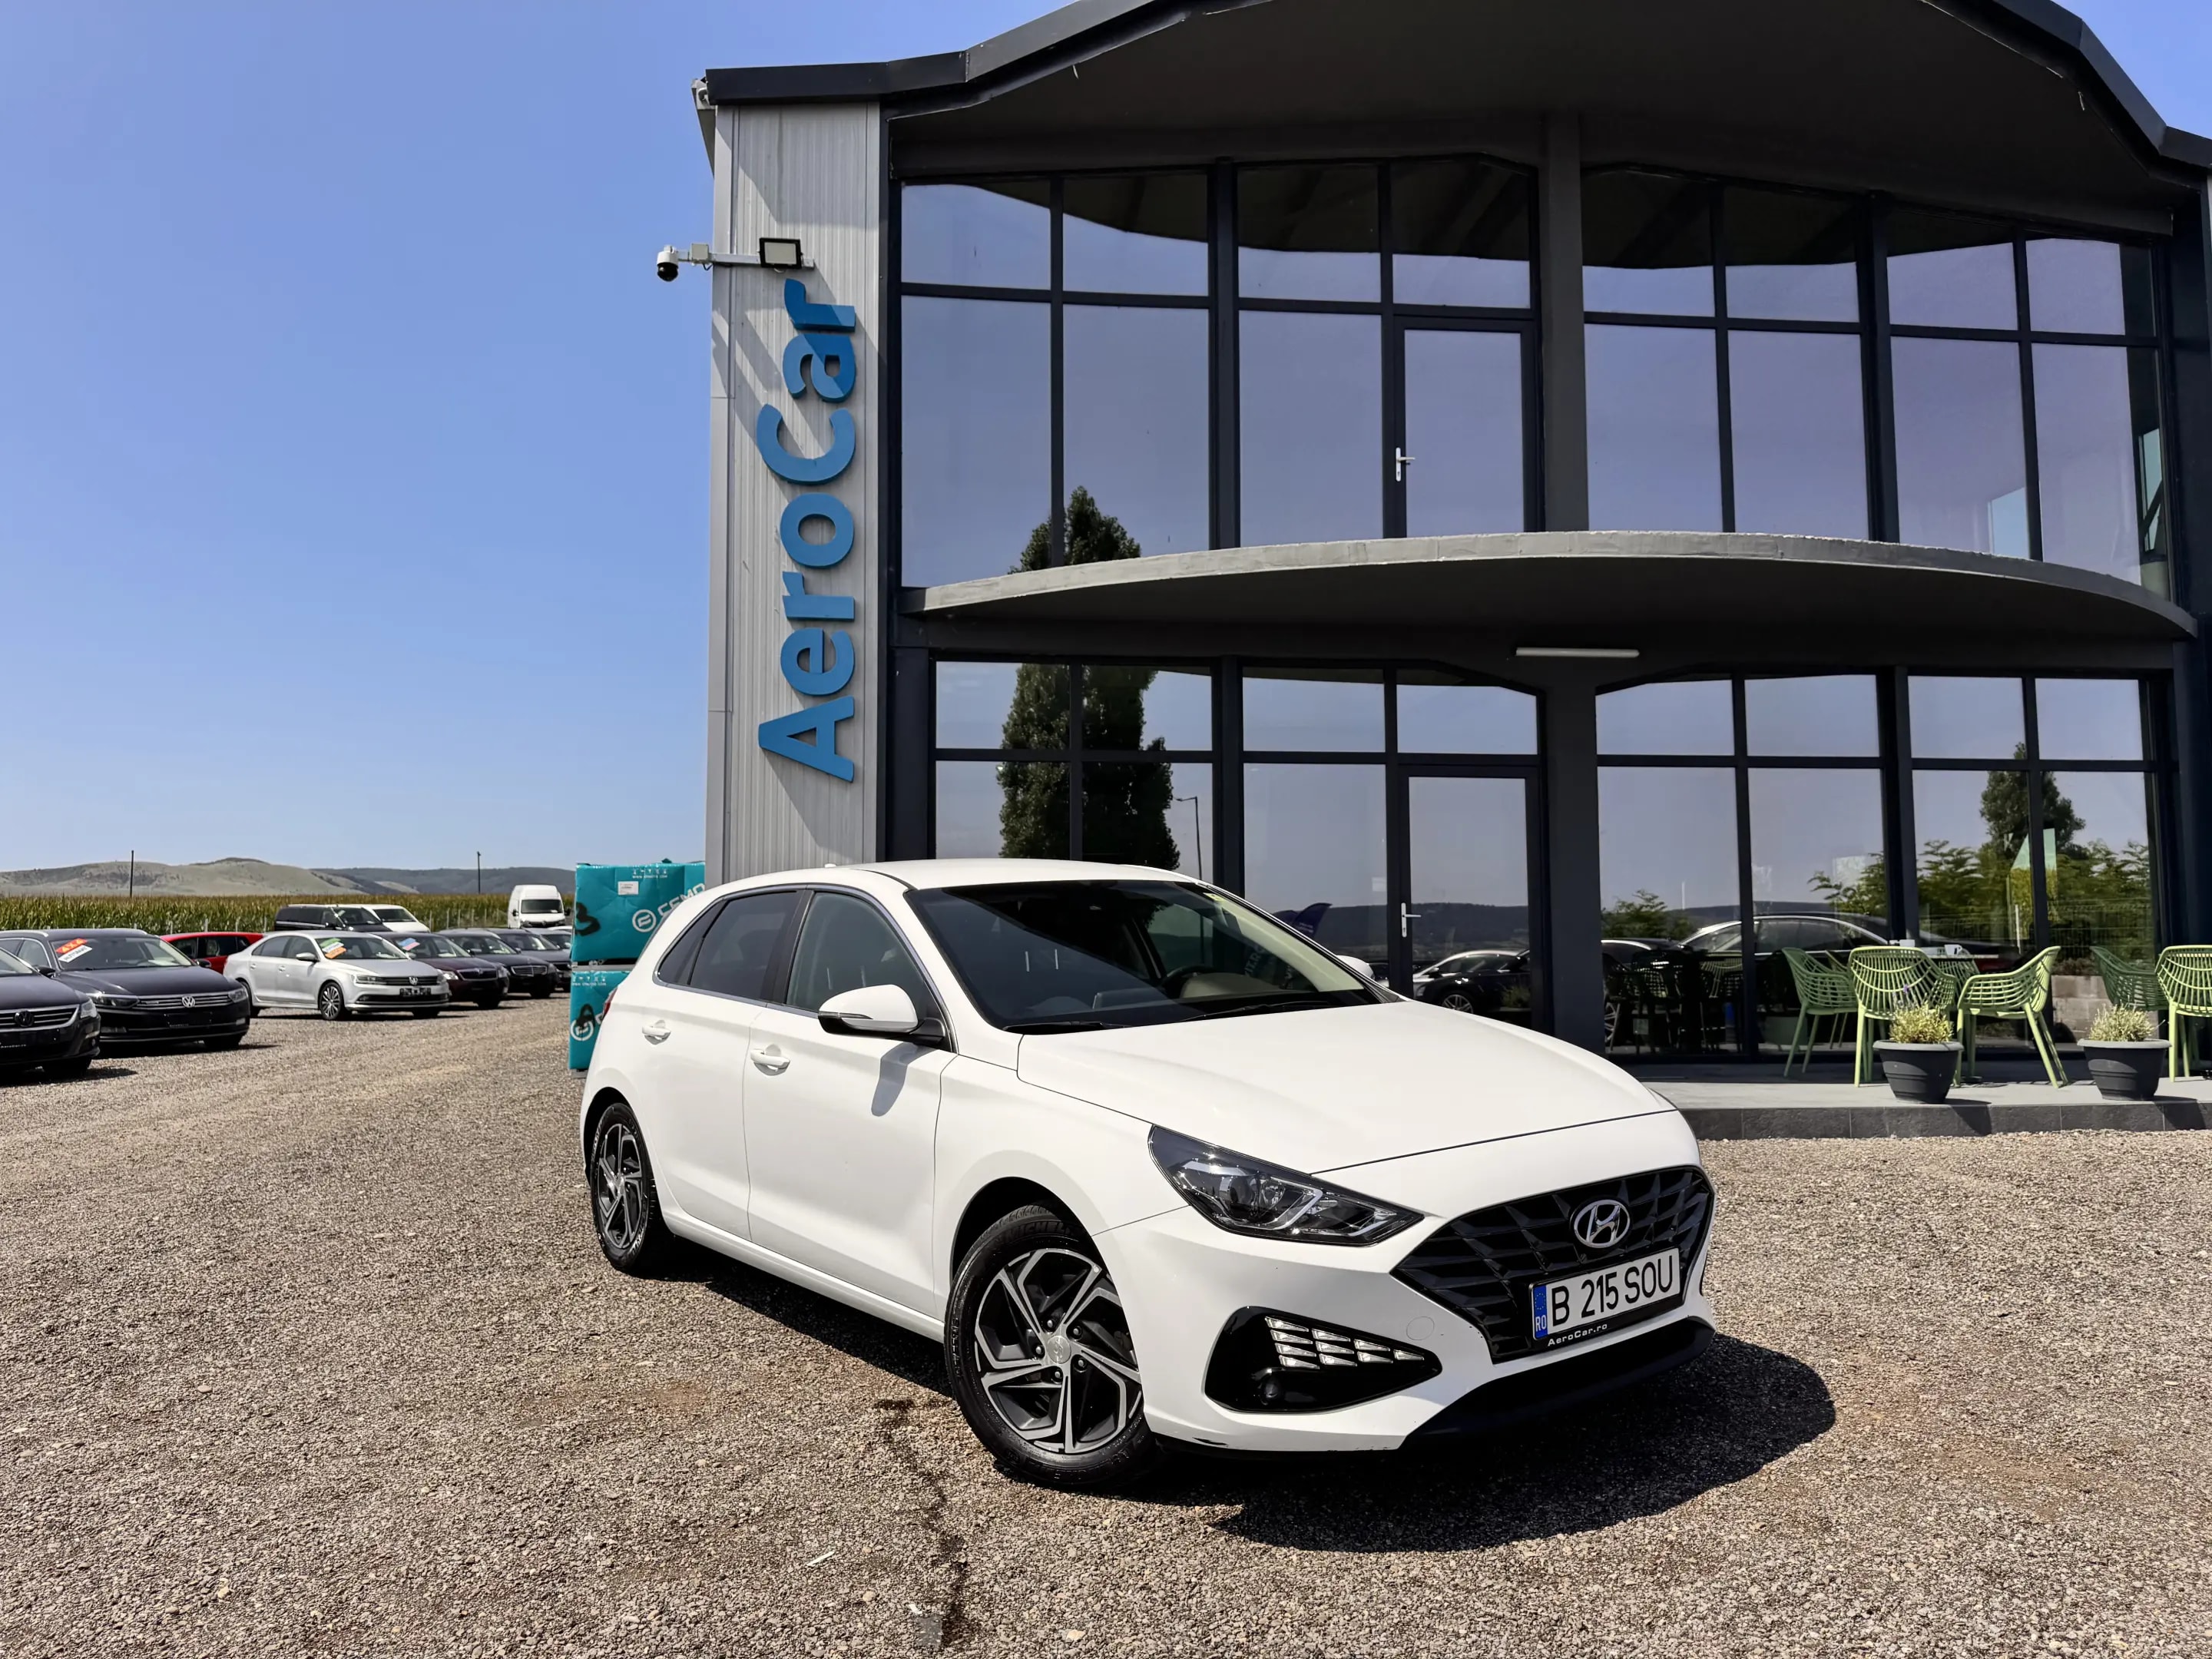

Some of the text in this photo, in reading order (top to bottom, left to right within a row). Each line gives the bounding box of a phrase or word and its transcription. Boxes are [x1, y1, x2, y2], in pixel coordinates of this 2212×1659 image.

[757, 278, 856, 783] AeroCar
[1551, 1255, 1673, 1327] B 215 SOU
[1535, 1314, 1547, 1333] RO
[1547, 1323, 1608, 1347] AeroCar.ro
